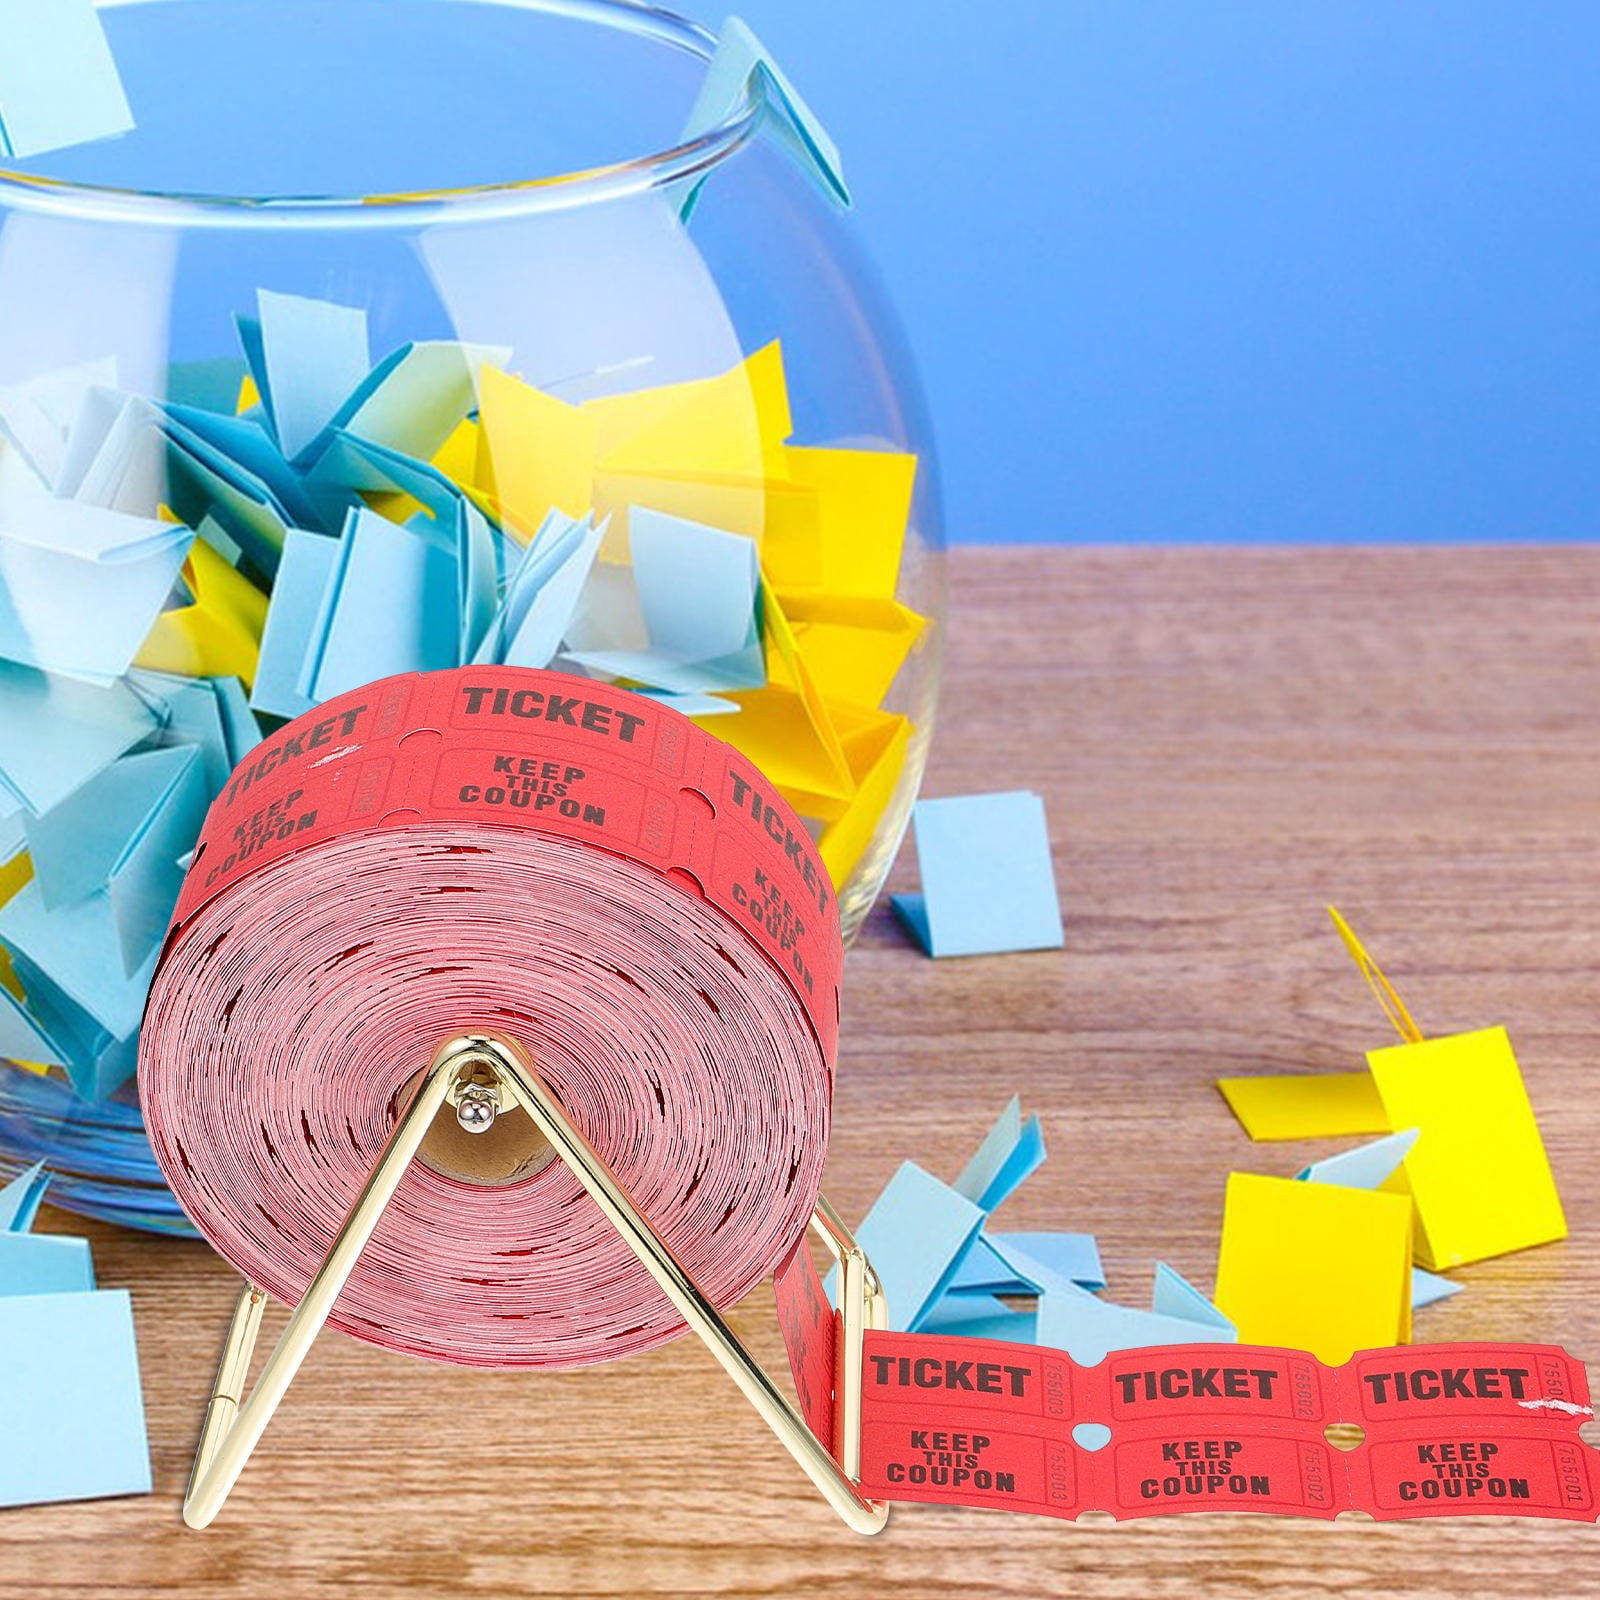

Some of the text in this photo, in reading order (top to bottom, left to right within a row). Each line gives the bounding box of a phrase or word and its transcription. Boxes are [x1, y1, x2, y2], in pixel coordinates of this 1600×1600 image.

[462, 687, 646, 743] TICKET
[225, 705, 368, 807] TICKET
[493, 756, 586, 785] KEEP
[459, 785, 606, 827] COUPON
[506, 774, 568, 799] THIS
[233, 789, 304, 841] KEEP
[239, 813, 288, 847] THIS
[203, 809, 318, 888] COUPON
[730, 771, 829, 917] TICKET
[754, 866, 806, 937] KEEP
[763, 893, 800, 947] THIS
[732, 883, 813, 994] COUPON
[870, 1355, 1032, 1397] TICKET
[1046, 1362, 1064, 1415] 755003
[1115, 1368, 1278, 1403] TICKET
[1292, 1365, 1315, 1418] 755002
[1364, 1368, 1529, 1404] TICKET
[911, 1431, 990, 1453] KEEP
[923, 1451, 978, 1469] THIS
[1162, 1441, 1242, 1461] KEEP
[1418, 1443, 1498, 1464] KEEP
[887, 1463, 1015, 1492] COUPON
[1049, 1447, 1068, 1502] 755003
[1140, 1476, 1270, 1499] COUPON
[1175, 1461, 1231, 1476] THIS
[1302, 1448, 1326, 1502] 755002
[1398, 1478, 1530, 1501] COUPON
[1432, 1463, 1490, 1479] THIS
[1559, 1448, 1583, 1502] 755001
